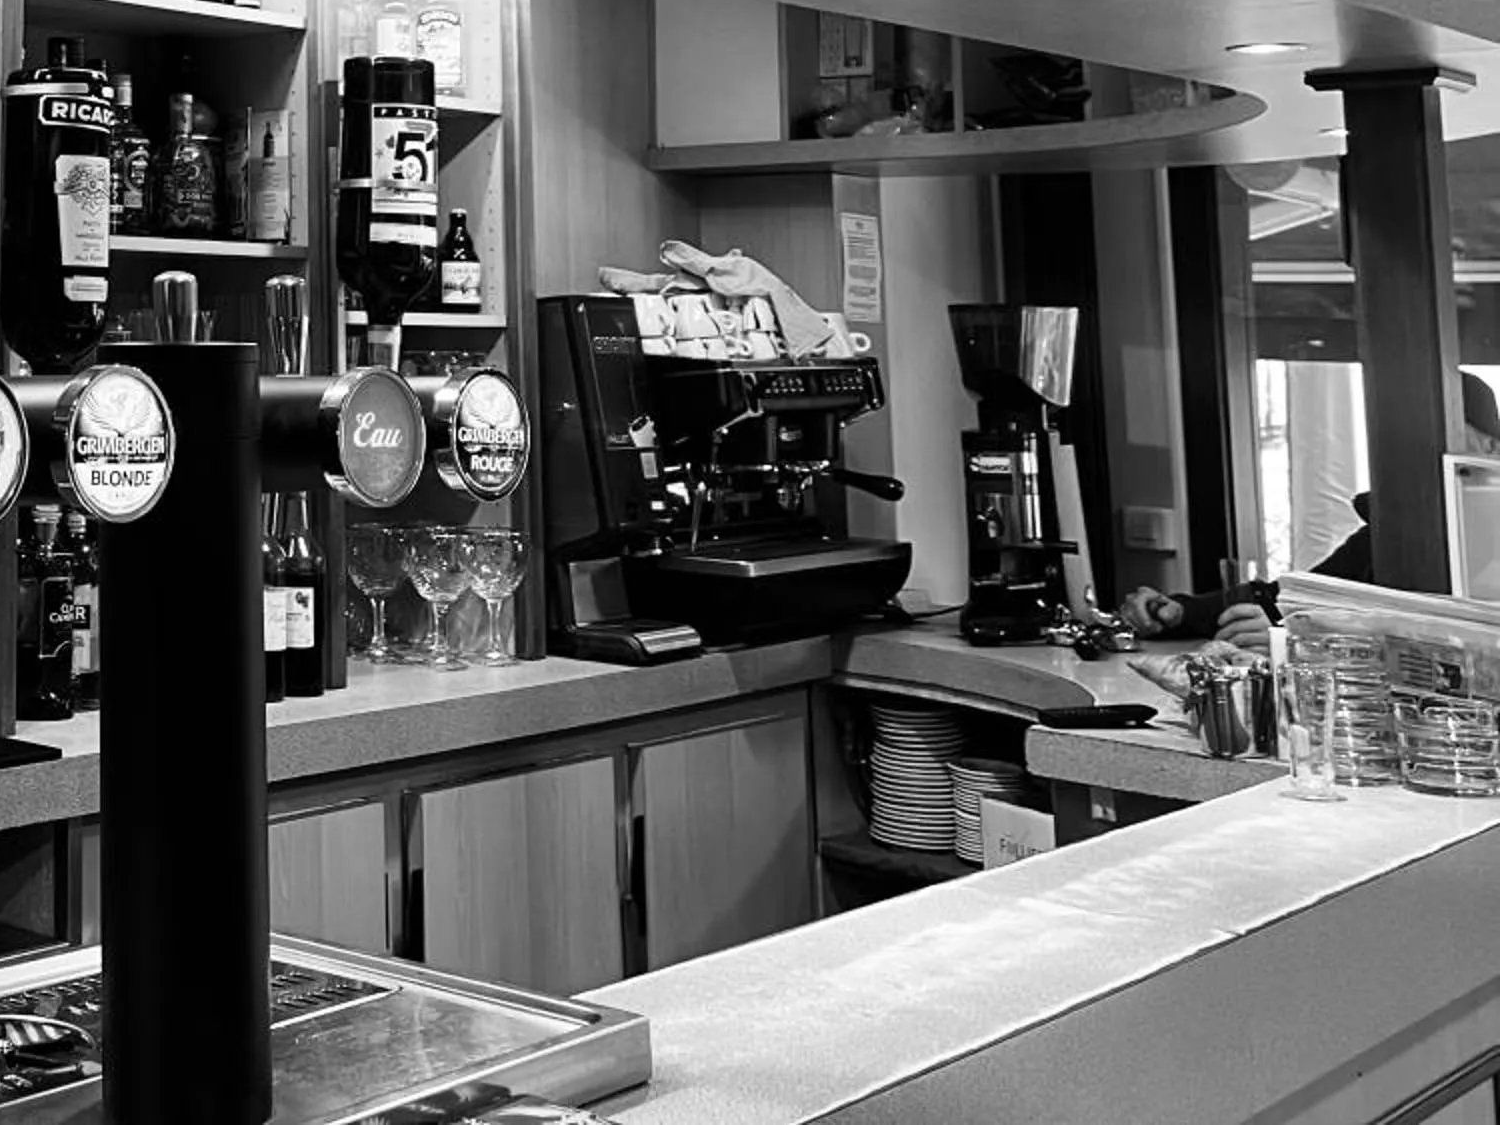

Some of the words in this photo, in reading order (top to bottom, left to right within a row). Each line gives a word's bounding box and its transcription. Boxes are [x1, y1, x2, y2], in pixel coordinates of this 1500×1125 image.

[353, 411, 402, 448] Eau
[77, 435, 165, 456] GRIMBERGEN
[471, 455, 514, 472] ROUGE
[91, 470, 153, 487] BLONDE
